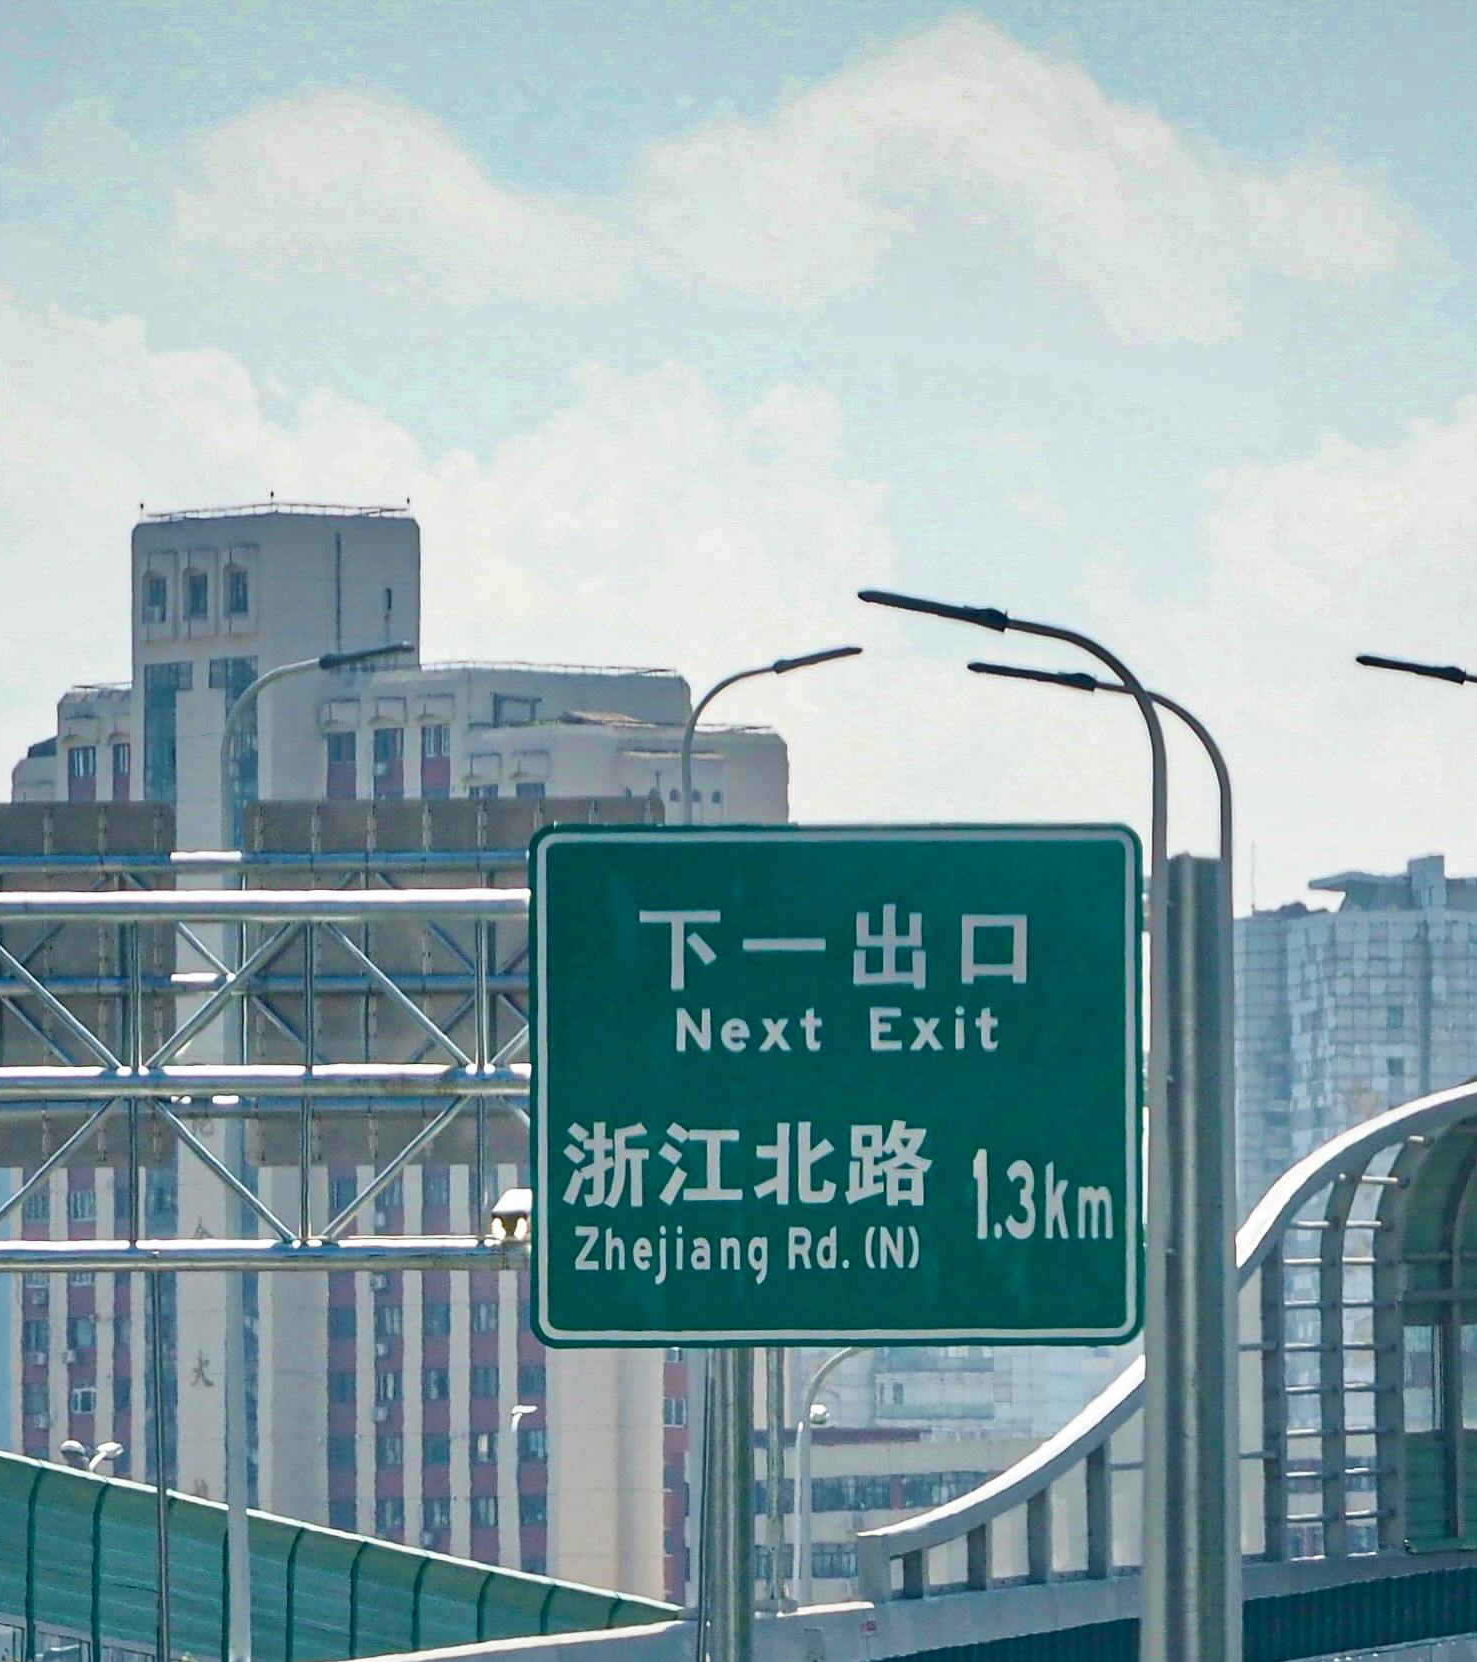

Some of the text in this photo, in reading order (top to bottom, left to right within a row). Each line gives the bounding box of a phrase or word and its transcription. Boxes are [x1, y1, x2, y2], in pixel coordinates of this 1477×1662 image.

[638, 903, 1028, 991] 下一出口
[675, 1005, 999, 1053] Next Exit
[562, 1119, 934, 1209] 浙江北路
[972, 1148, 1114, 1240] 1.3km
[574, 1224, 921, 1286] Zhejiang Rd. (N)
